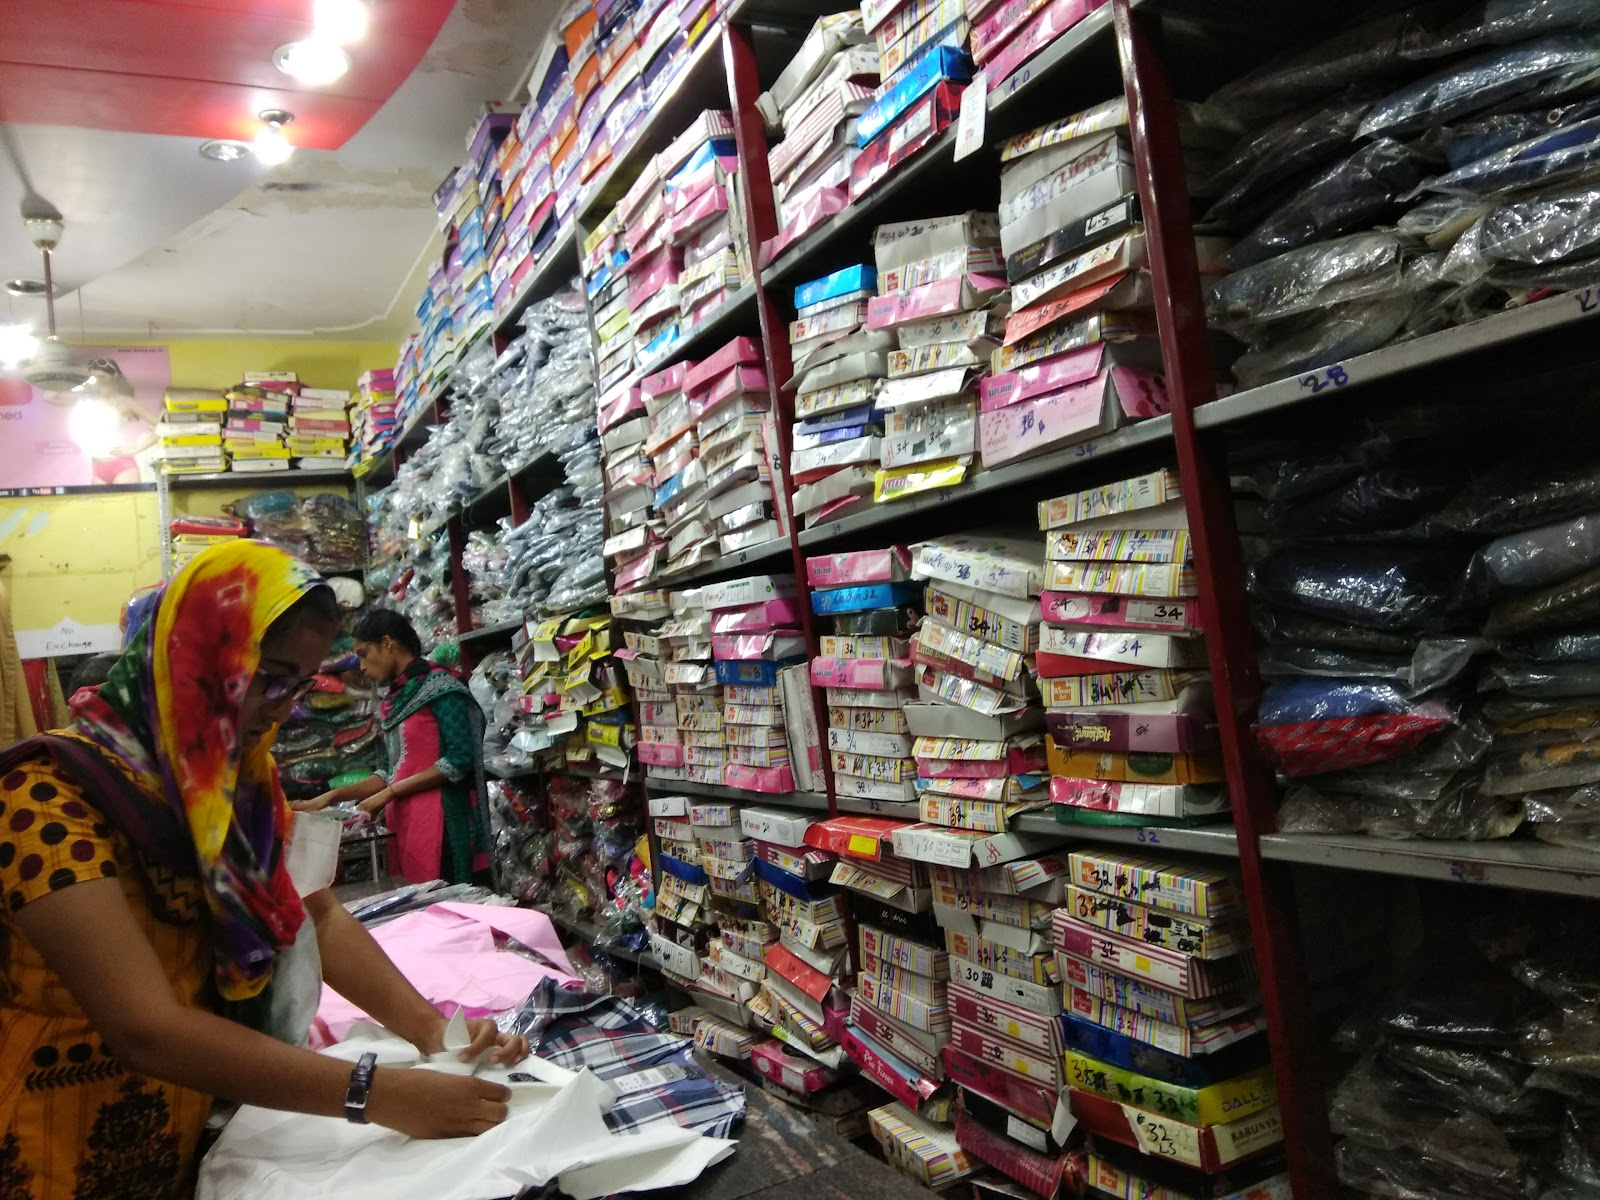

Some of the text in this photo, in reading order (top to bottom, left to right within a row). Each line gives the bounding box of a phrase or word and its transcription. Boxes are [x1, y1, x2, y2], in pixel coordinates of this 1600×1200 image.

[1306, 365, 1349, 393] 28
[928, 429, 944, 445] 34
[896, 440, 910, 455] 34
[1076, 443, 1098, 457] 34
[1128, 533, 1149, 553] 34
[989, 567, 1010, 586] 34
[1052, 598, 1072, 611] 34
[1154, 606, 1184, 619] 34
[60, 627, 75, 635] No
[968, 616, 990, 636] 34
[46, 641, 93, 651] Exchange
[845, 644, 856, 655] 32
[1060, 634, 1142, 657] 34 34
[869, 800, 881, 812] 32
[1137, 830, 1160, 844] 32
[1091, 870, 1112, 890] 32
[1100, 942, 1117, 958] 32
[966, 967, 979, 981] 30
[1148, 1122, 1172, 1142] 32
[1231, 1117, 1279, 1142] KARUNYA
[1159, 1143, 1177, 1155] LS
